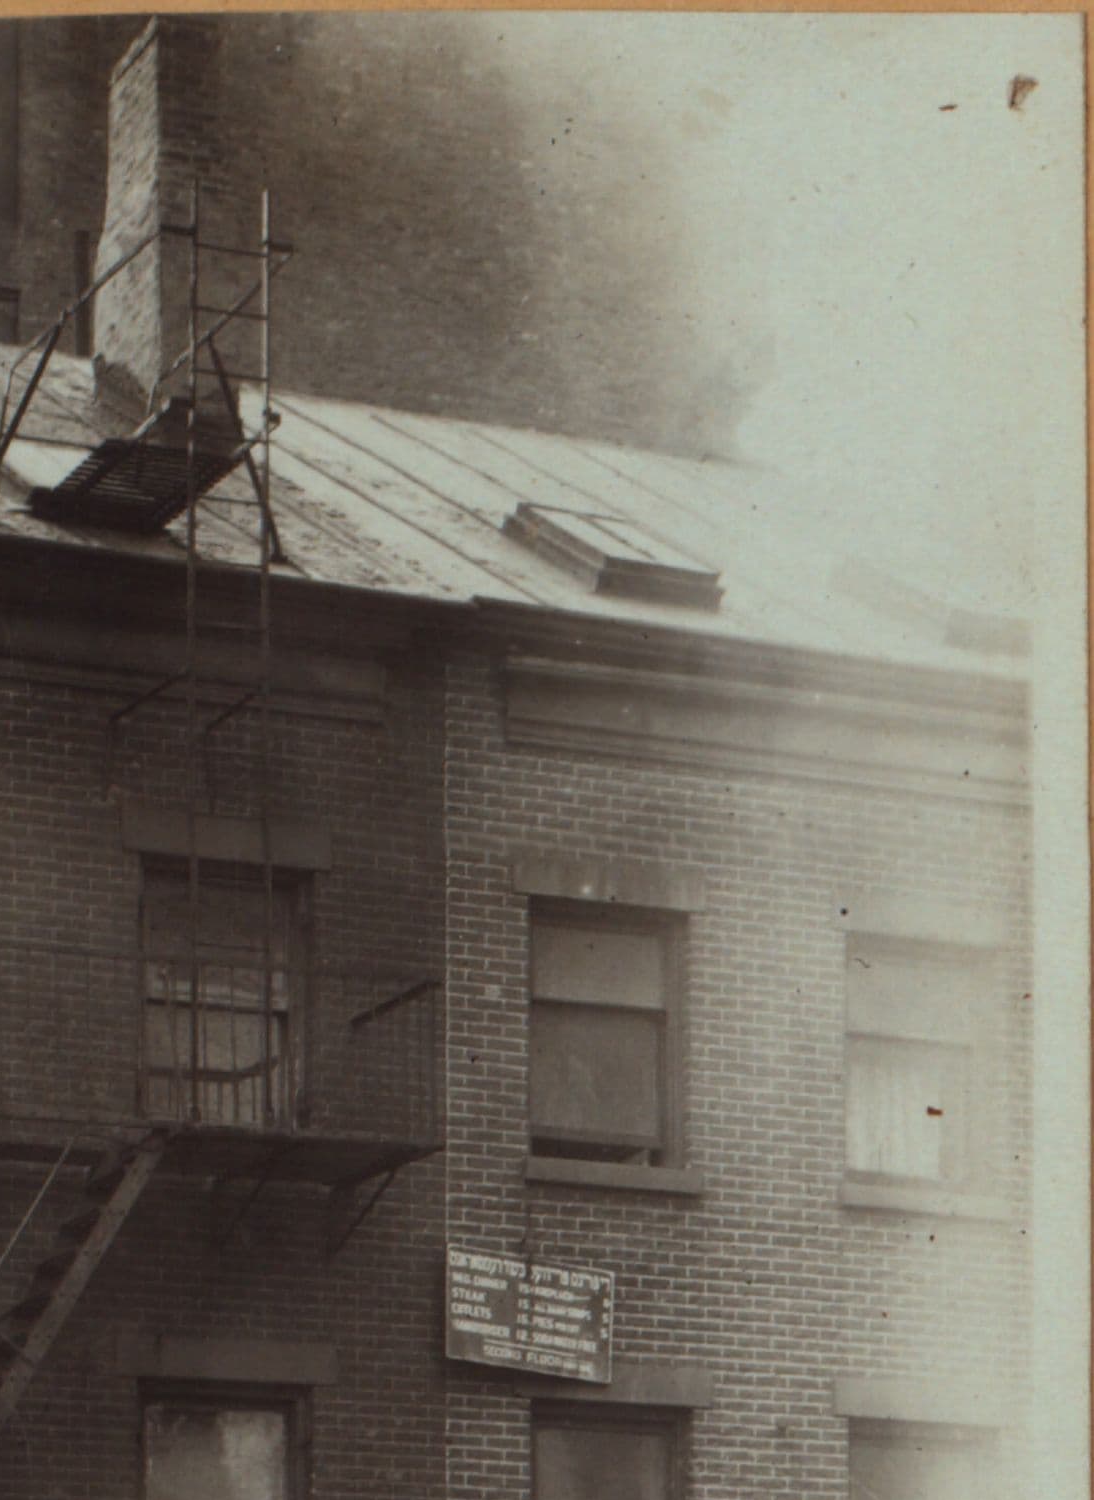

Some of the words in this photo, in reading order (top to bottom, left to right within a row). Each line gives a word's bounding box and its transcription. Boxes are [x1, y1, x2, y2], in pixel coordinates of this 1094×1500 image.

[451, 1287, 487, 1303] STEAK
[483, 1344, 522, 1361] SECOND
[526, 1351, 563, 1366] FLOOR
